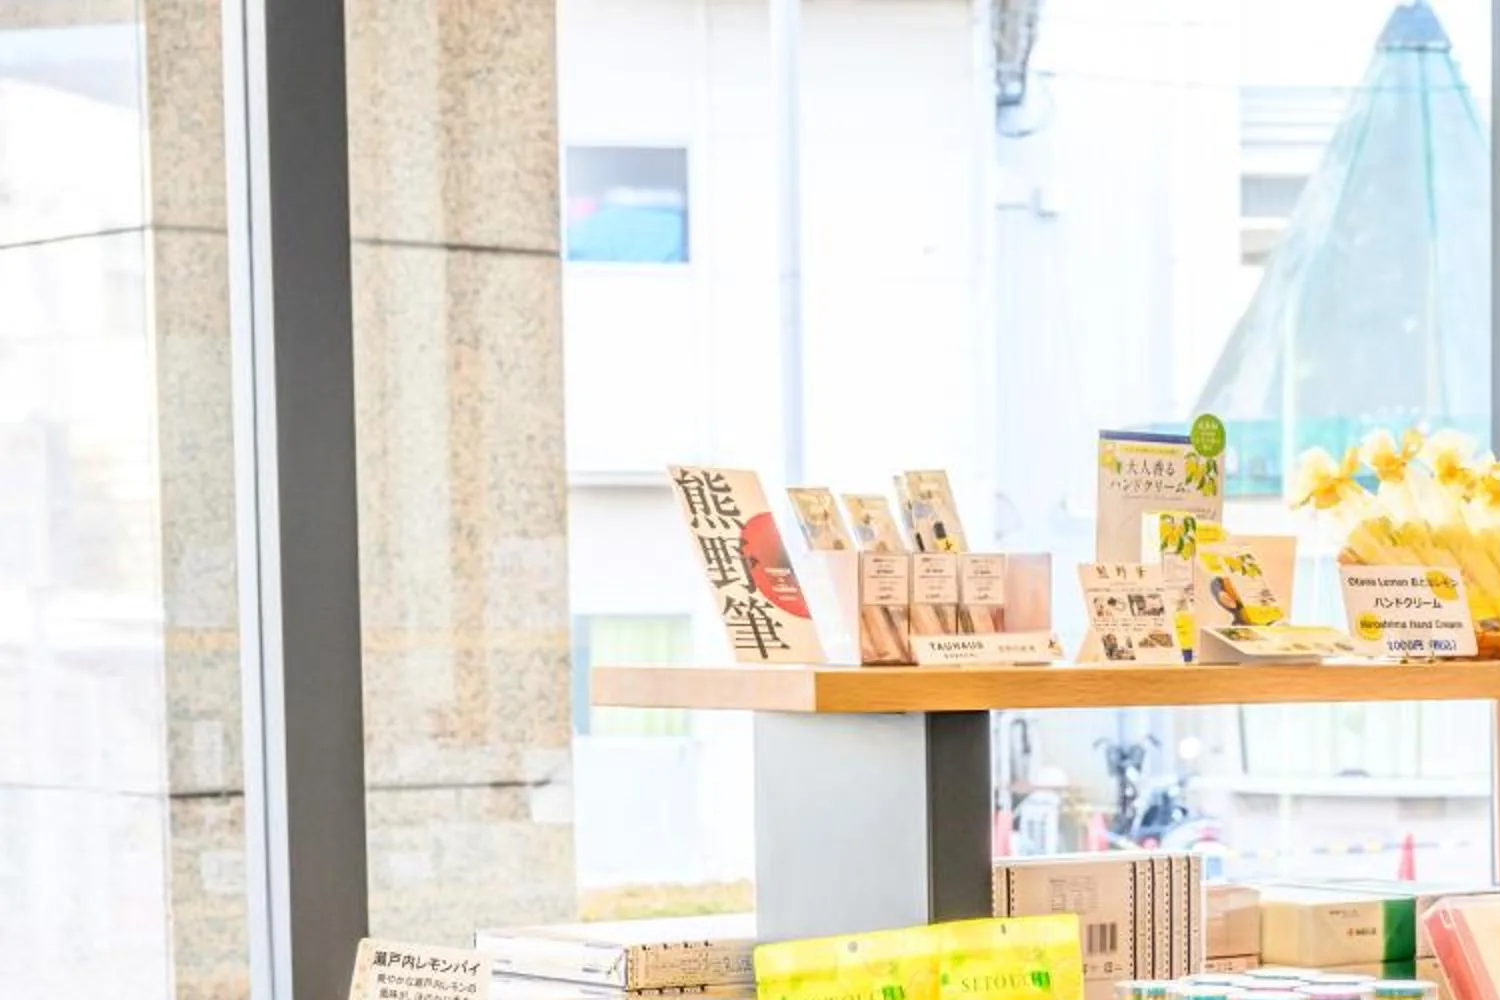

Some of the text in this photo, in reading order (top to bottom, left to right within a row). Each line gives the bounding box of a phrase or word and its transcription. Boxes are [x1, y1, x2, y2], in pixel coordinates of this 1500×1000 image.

[675, 467, 790, 660] 熊野筆
[1373, 597, 1443, 609] ハンドクリーム
[371, 950, 481, 976] 瀬戸内レモンパイ
